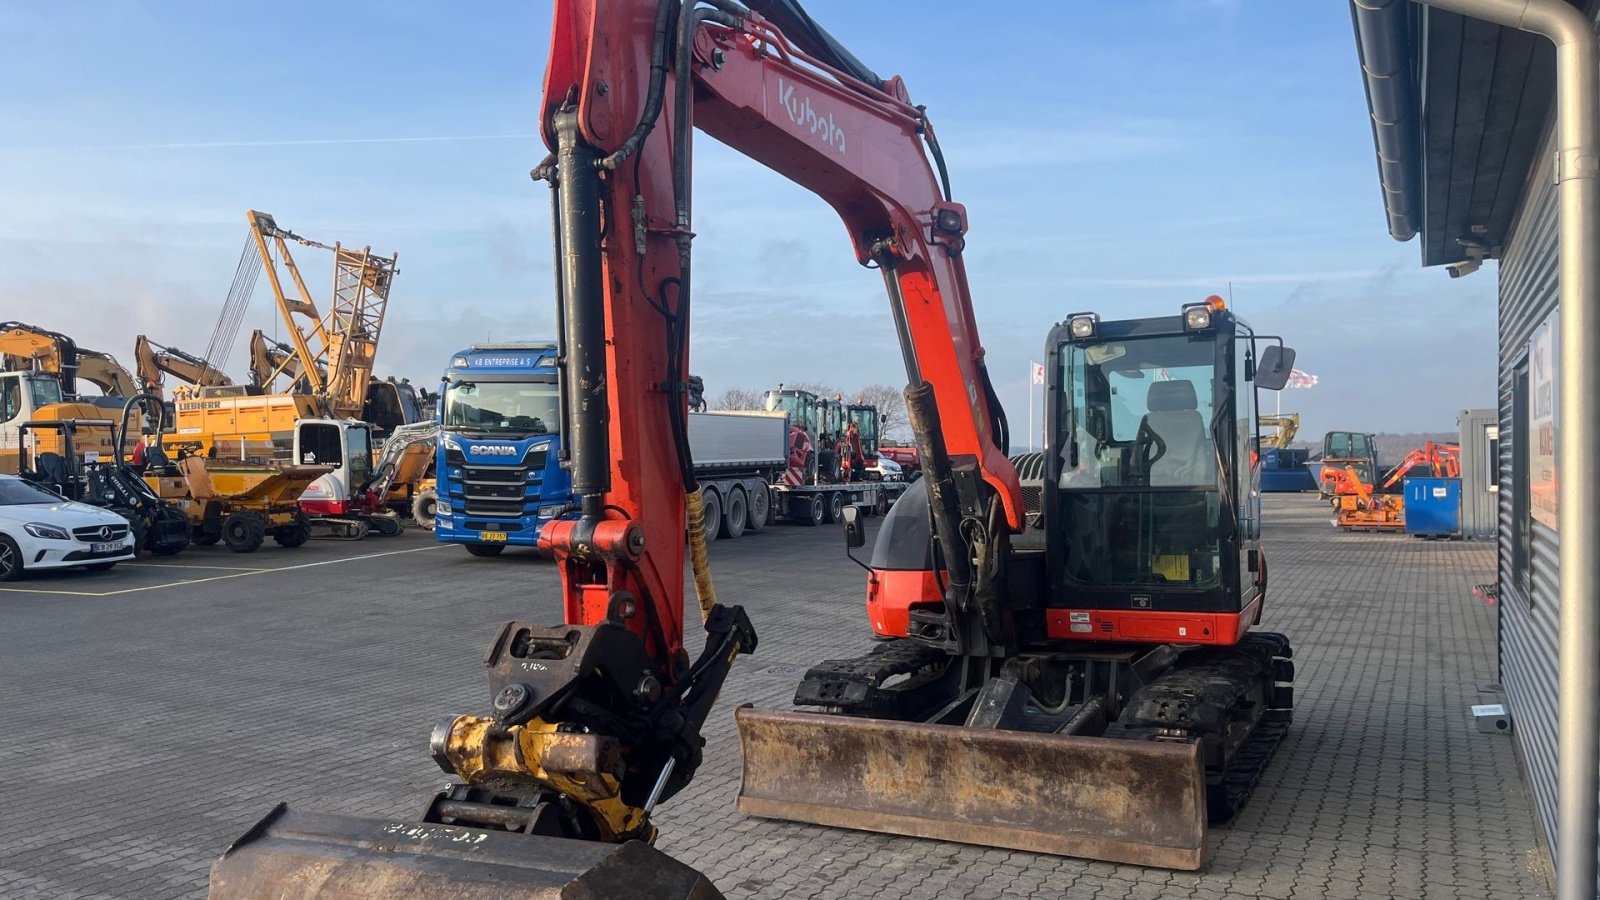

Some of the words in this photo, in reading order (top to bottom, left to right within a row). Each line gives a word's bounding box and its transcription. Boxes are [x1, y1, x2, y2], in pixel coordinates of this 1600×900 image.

[779, 78, 846, 154] Kubota
[484, 358, 518, 366] ENTREPRISE
[179, 401, 221, 410] LIEBHERR
[469, 445, 518, 456] SCANIA
